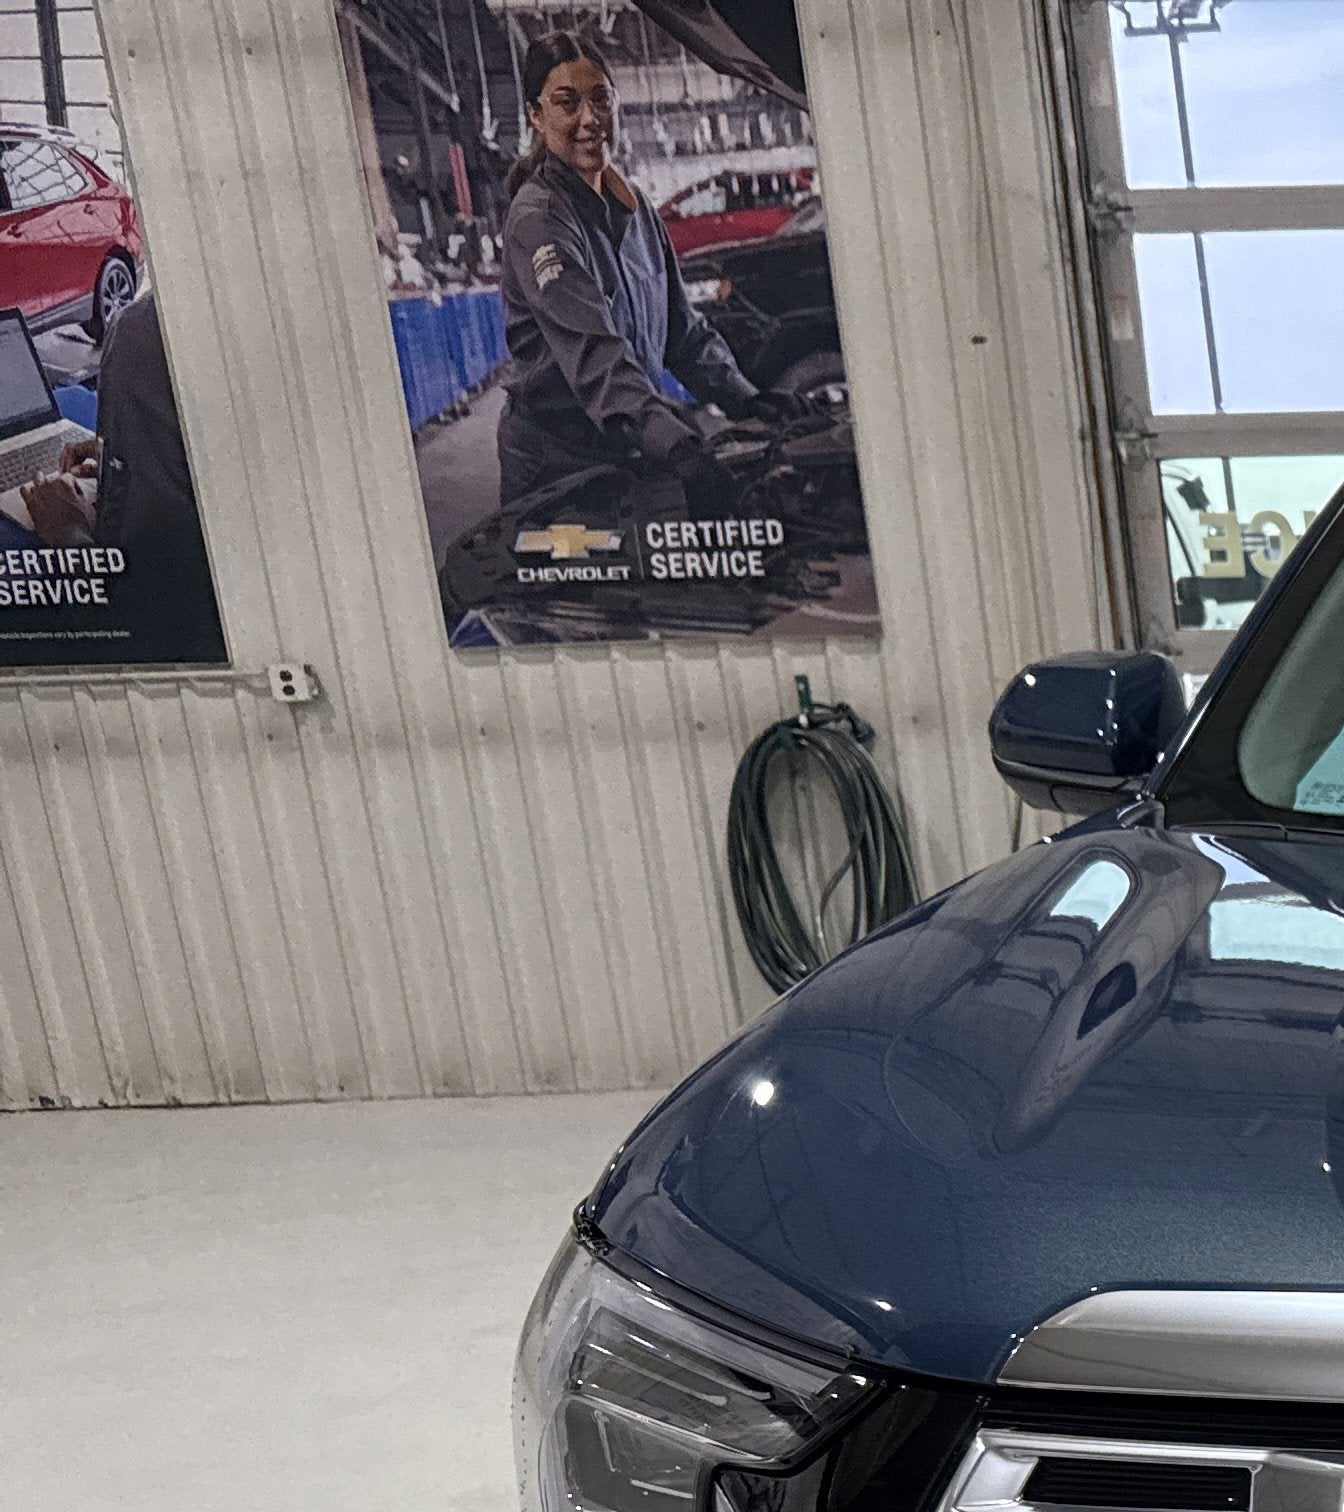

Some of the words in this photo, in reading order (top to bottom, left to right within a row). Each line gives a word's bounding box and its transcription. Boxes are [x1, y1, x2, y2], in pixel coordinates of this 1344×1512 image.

[645, 519, 785, 549] CERTIFIED
[517, 565, 631, 582] CHEVROLET
[650, 550, 766, 579] SERVICE
[0, 578, 109, 605] SERVICE
